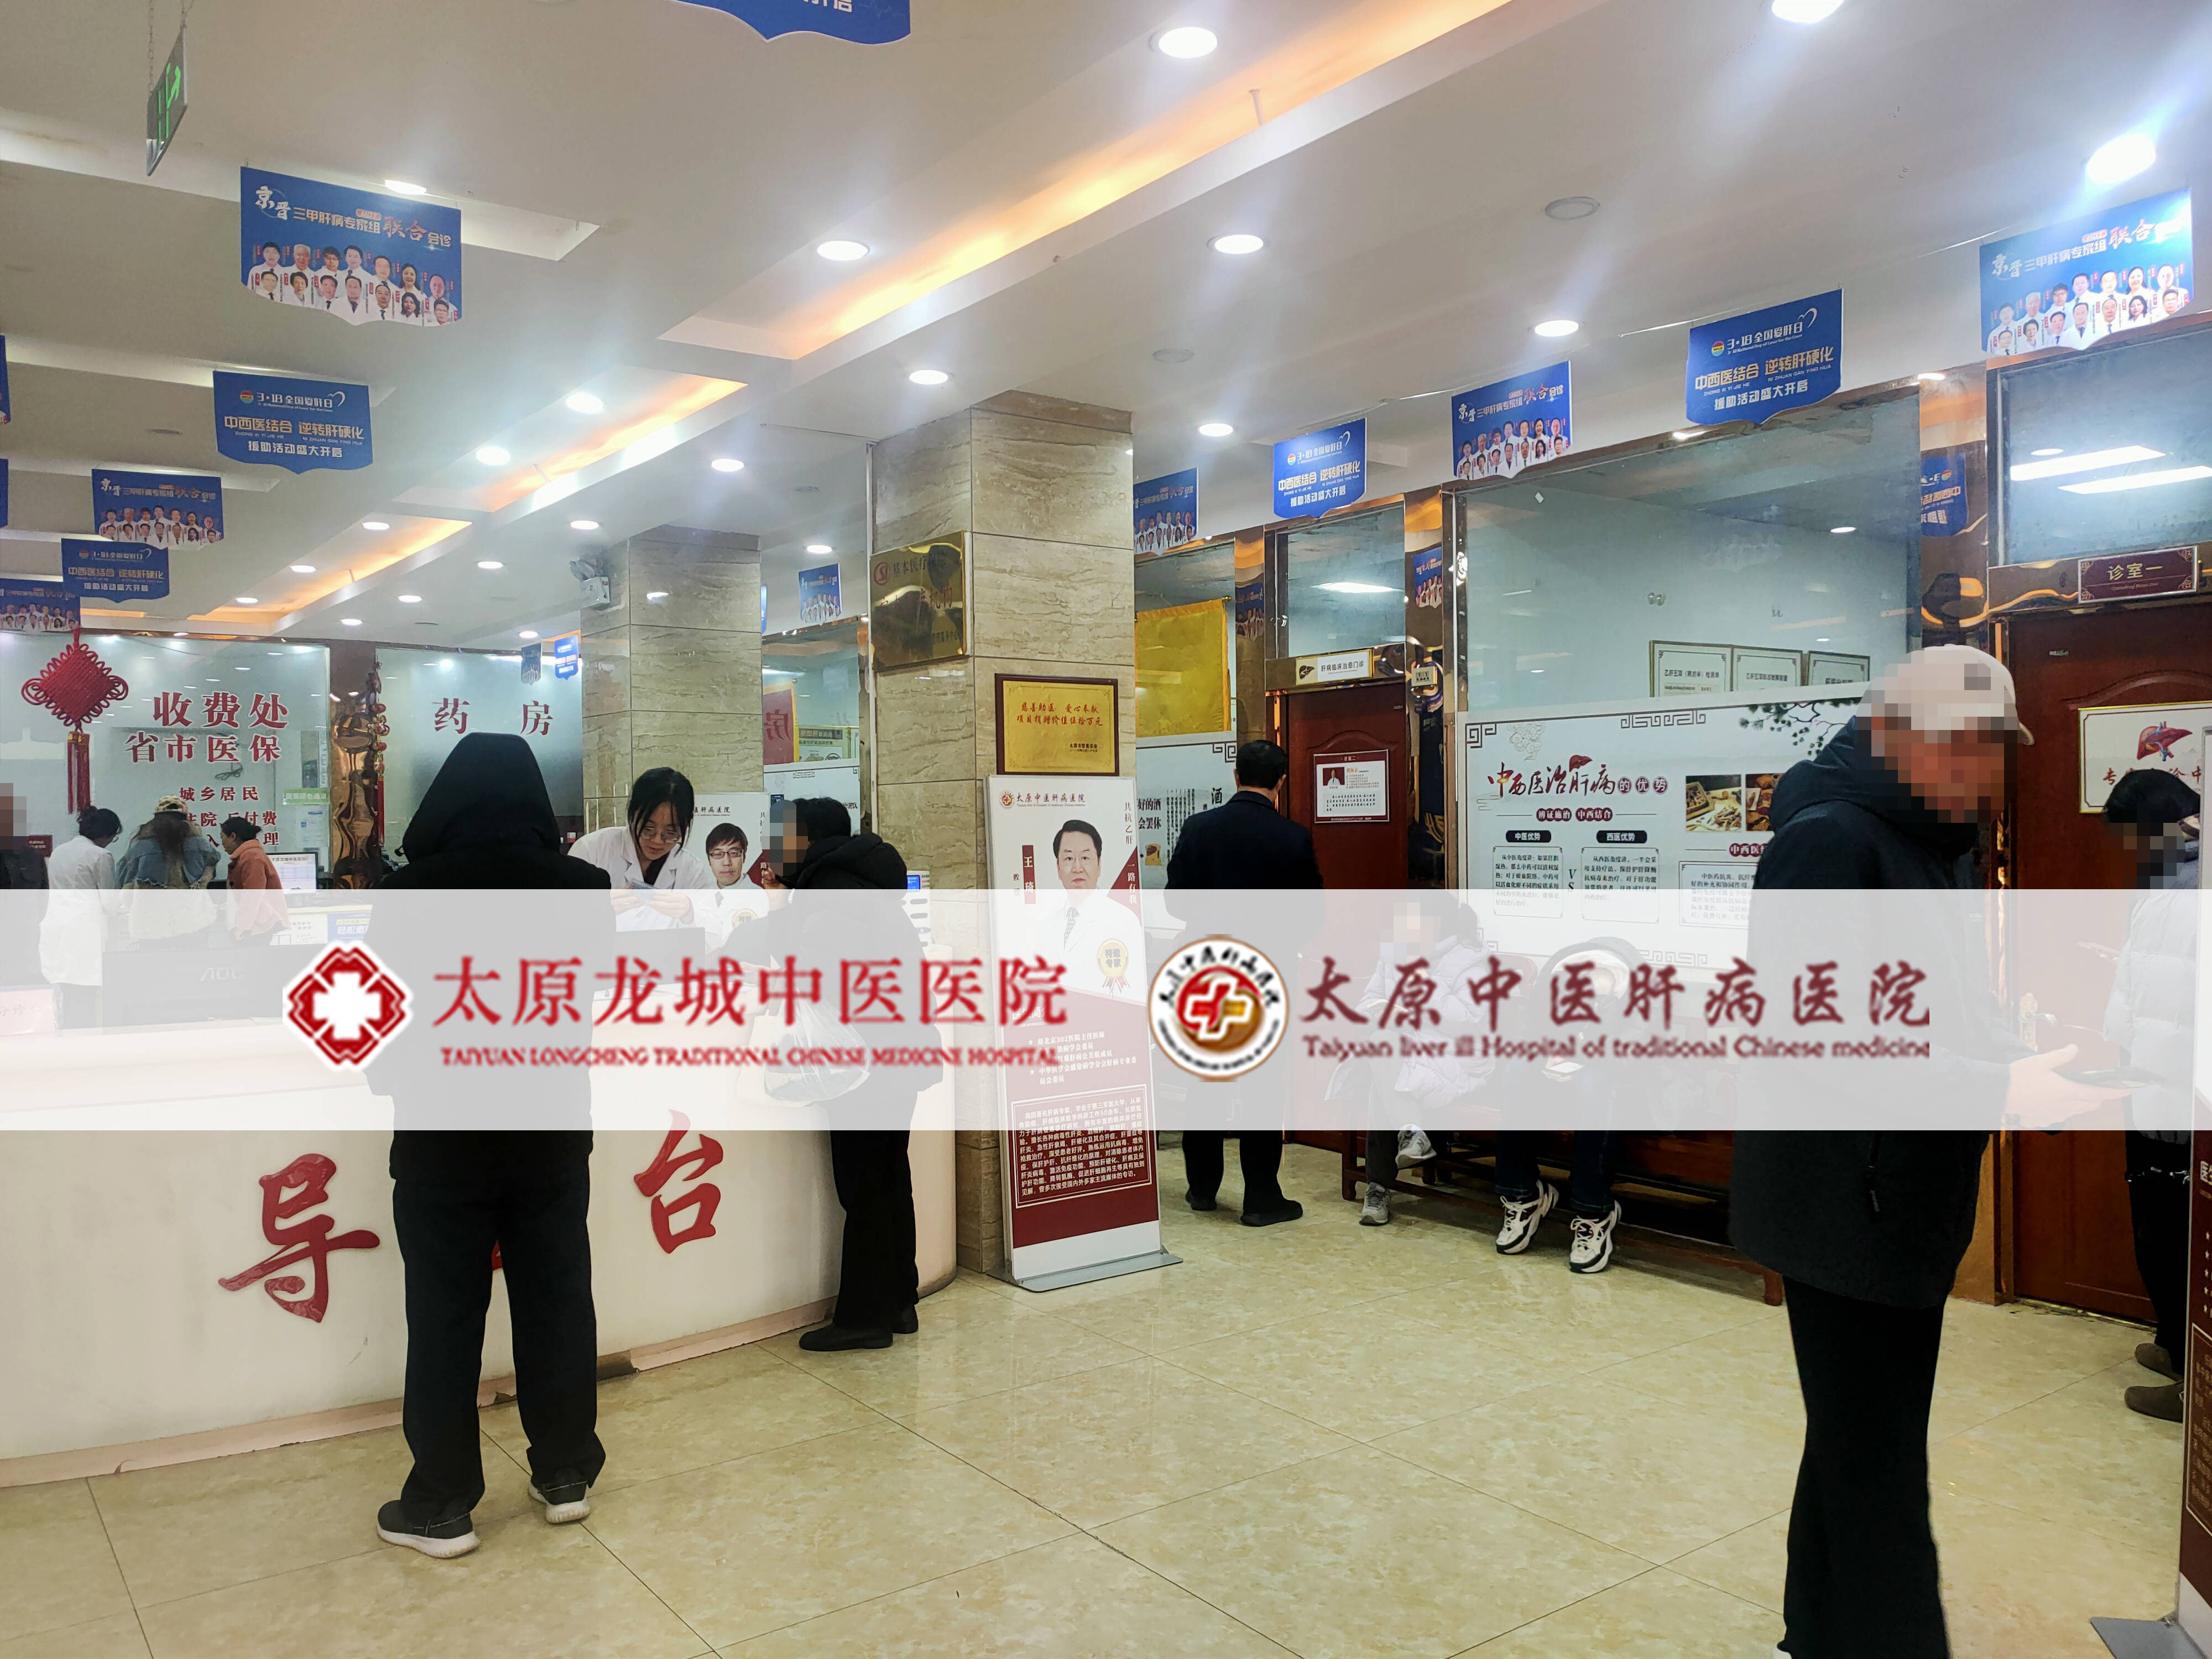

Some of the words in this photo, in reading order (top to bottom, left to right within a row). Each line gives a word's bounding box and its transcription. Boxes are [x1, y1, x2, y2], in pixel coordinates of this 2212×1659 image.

[1695, 363, 1759, 390] 中西医结合
[1765, 346, 1834, 375] 逆转肝硬化
[1714, 379, 1808, 410] 援助活动盛大开启
[224, 416, 292, 434] 中西医结合
[299, 421, 365, 440] 逆转肝硬化
[248, 440, 343, 458] 援助活动盛大开启
[2106, 562, 2163, 581] 诊室一
[1321, 660, 1364, 672] 肝病临床治愈门诊
[153, 691, 289, 729] 收费处
[125, 731, 282, 764] 省市医保
[179, 786, 259, 802] 城乡居民
[1124, 801, 1133, 845] 共抗乙肝
[1514, 832, 1541, 842] 中医优势
[1606, 832, 1636, 842] 西医优势
[218, 1109, 724, 1323] 导台
